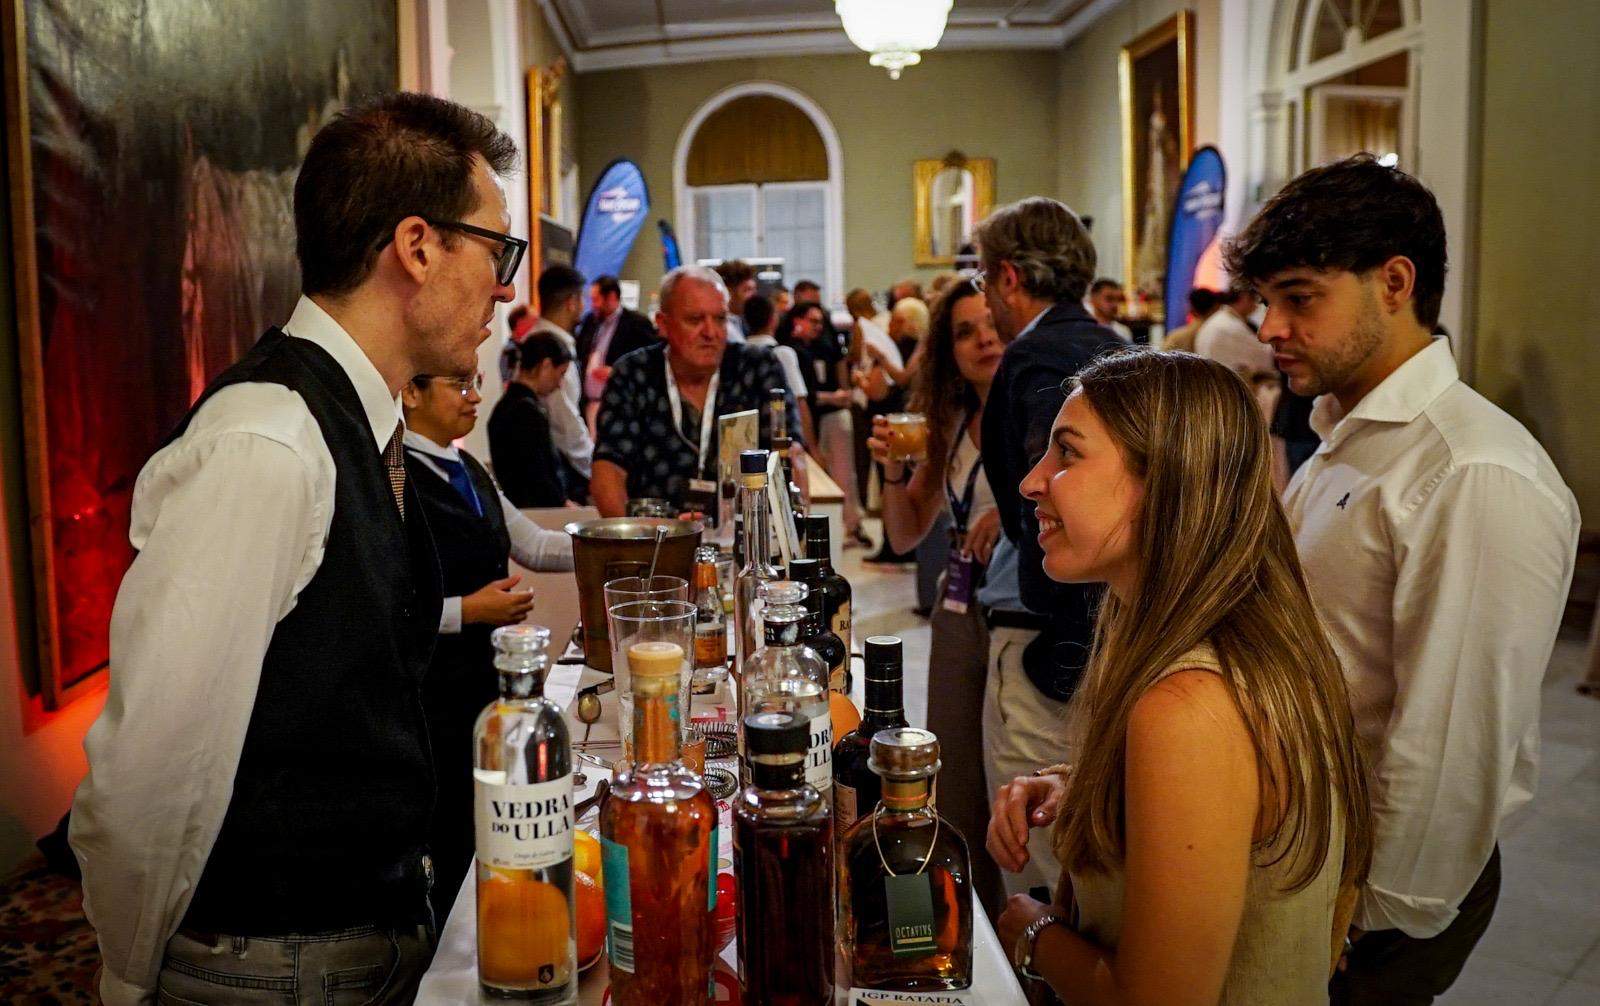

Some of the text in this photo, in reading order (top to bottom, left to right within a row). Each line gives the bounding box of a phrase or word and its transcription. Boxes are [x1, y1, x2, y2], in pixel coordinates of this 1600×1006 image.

[491, 794, 569, 819] VEDRA
[492, 816, 570, 841] DO ULLA
[861, 991, 963, 1004] IGP RATAFIA
